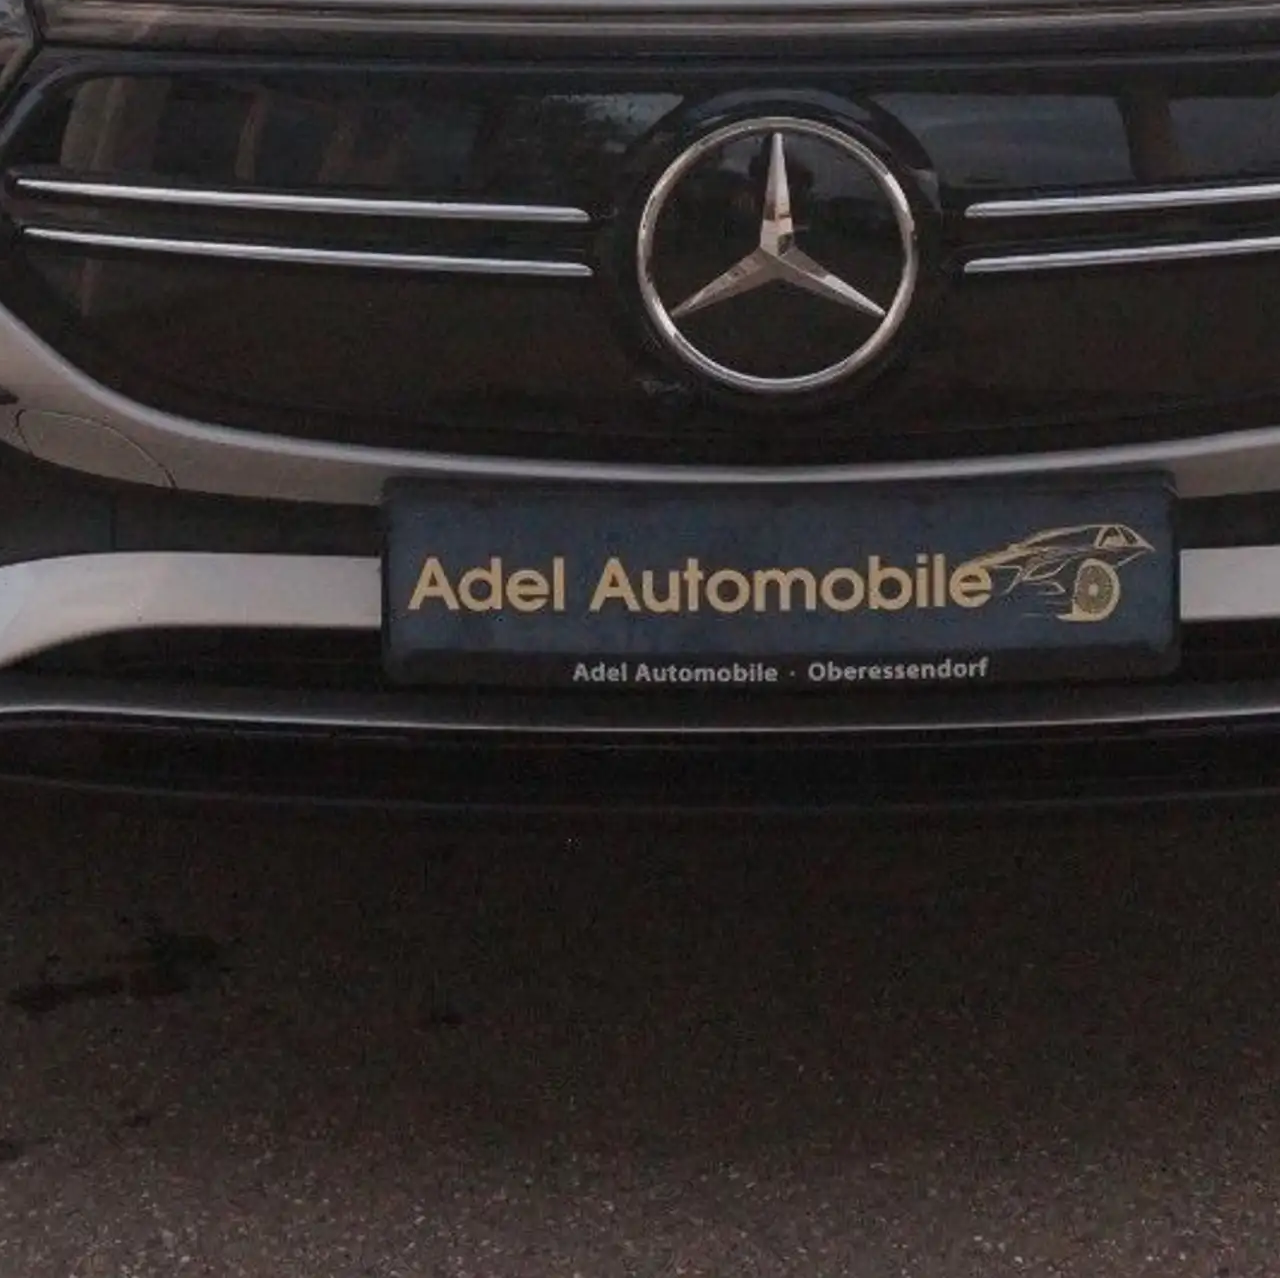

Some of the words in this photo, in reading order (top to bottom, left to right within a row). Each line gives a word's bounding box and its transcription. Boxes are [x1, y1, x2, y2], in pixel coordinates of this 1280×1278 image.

[407, 556, 565, 612] Adel
[589, 553, 993, 613] Automobile
[572, 661, 628, 683] Adel
[634, 662, 779, 683] Automobile
[807, 656, 990, 682] Oberessendorf
